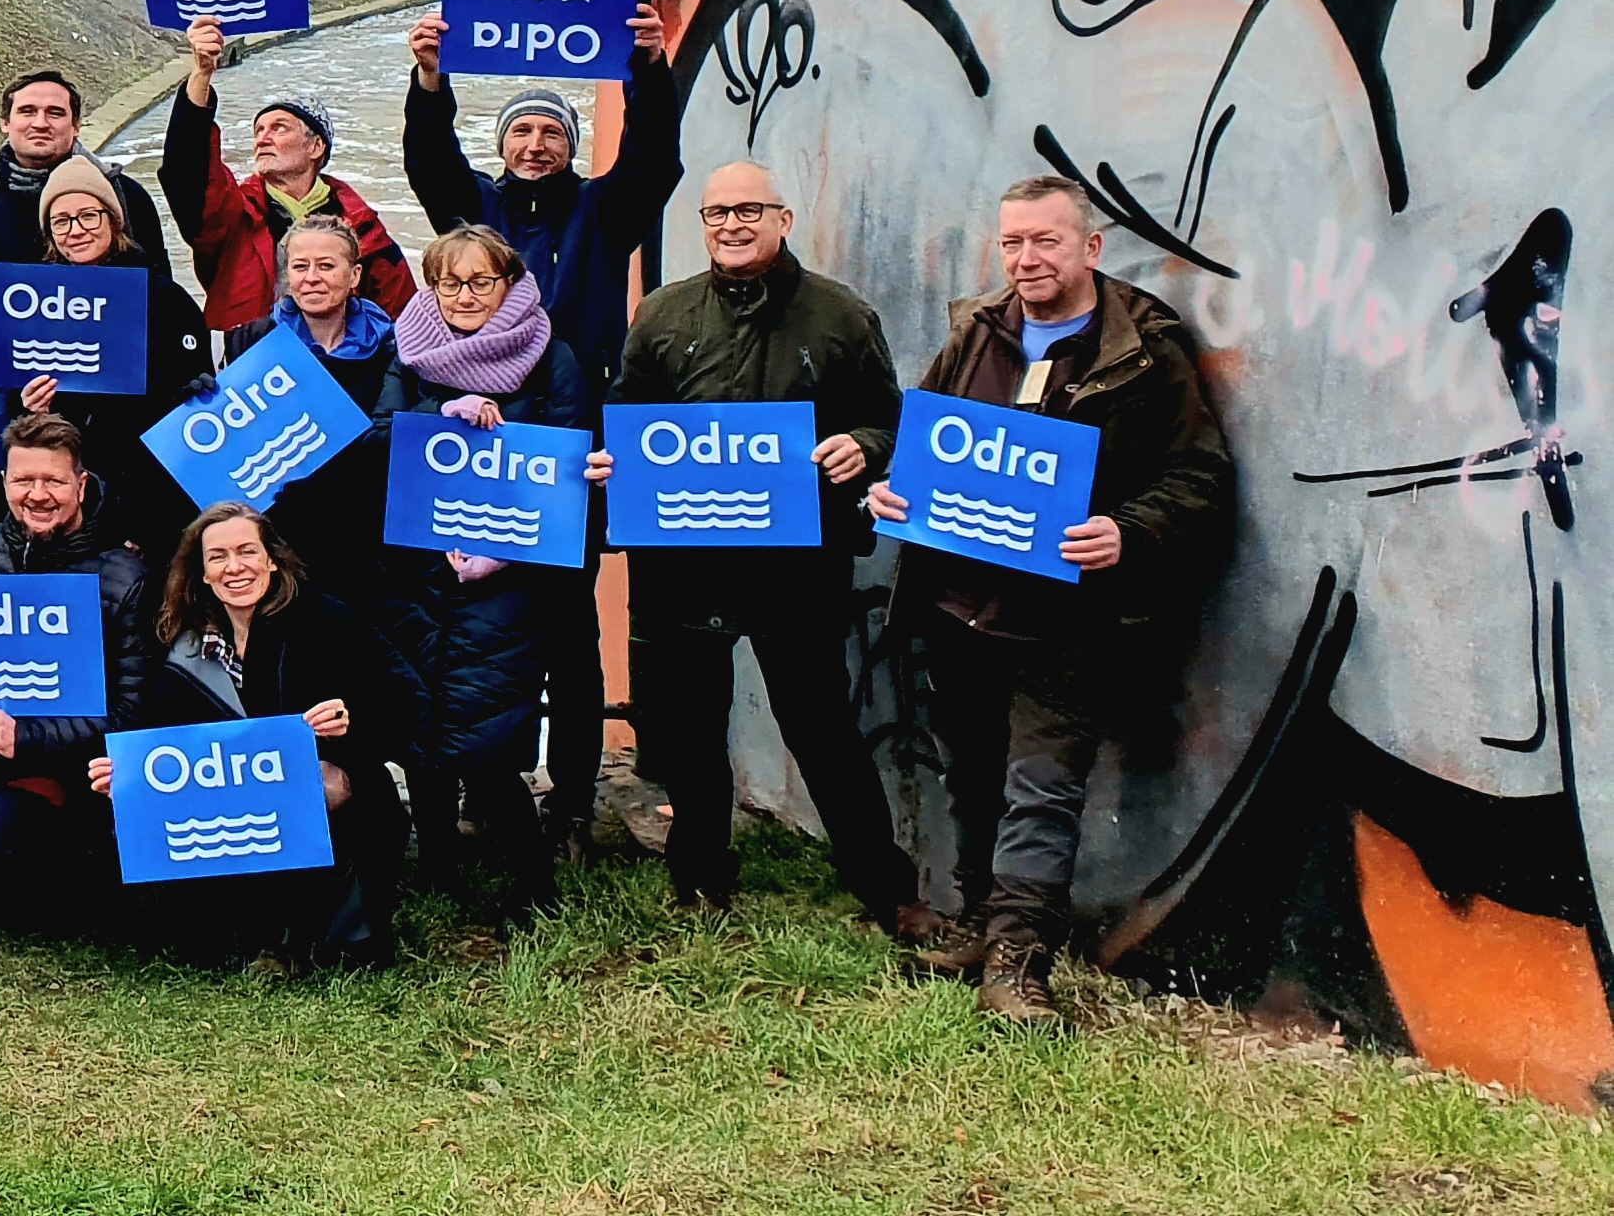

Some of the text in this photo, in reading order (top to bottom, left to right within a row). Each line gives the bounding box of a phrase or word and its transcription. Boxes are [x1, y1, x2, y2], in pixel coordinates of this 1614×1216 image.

[473, 21, 601, 64] Odra
[2, 283, 107, 321] Oder
[183, 364, 297, 453] Odra
[425, 431, 556, 486] Odra
[641, 420, 781, 465] Odra
[930, 415, 1058, 486] Odra
[144, 742, 285, 793] Odra
